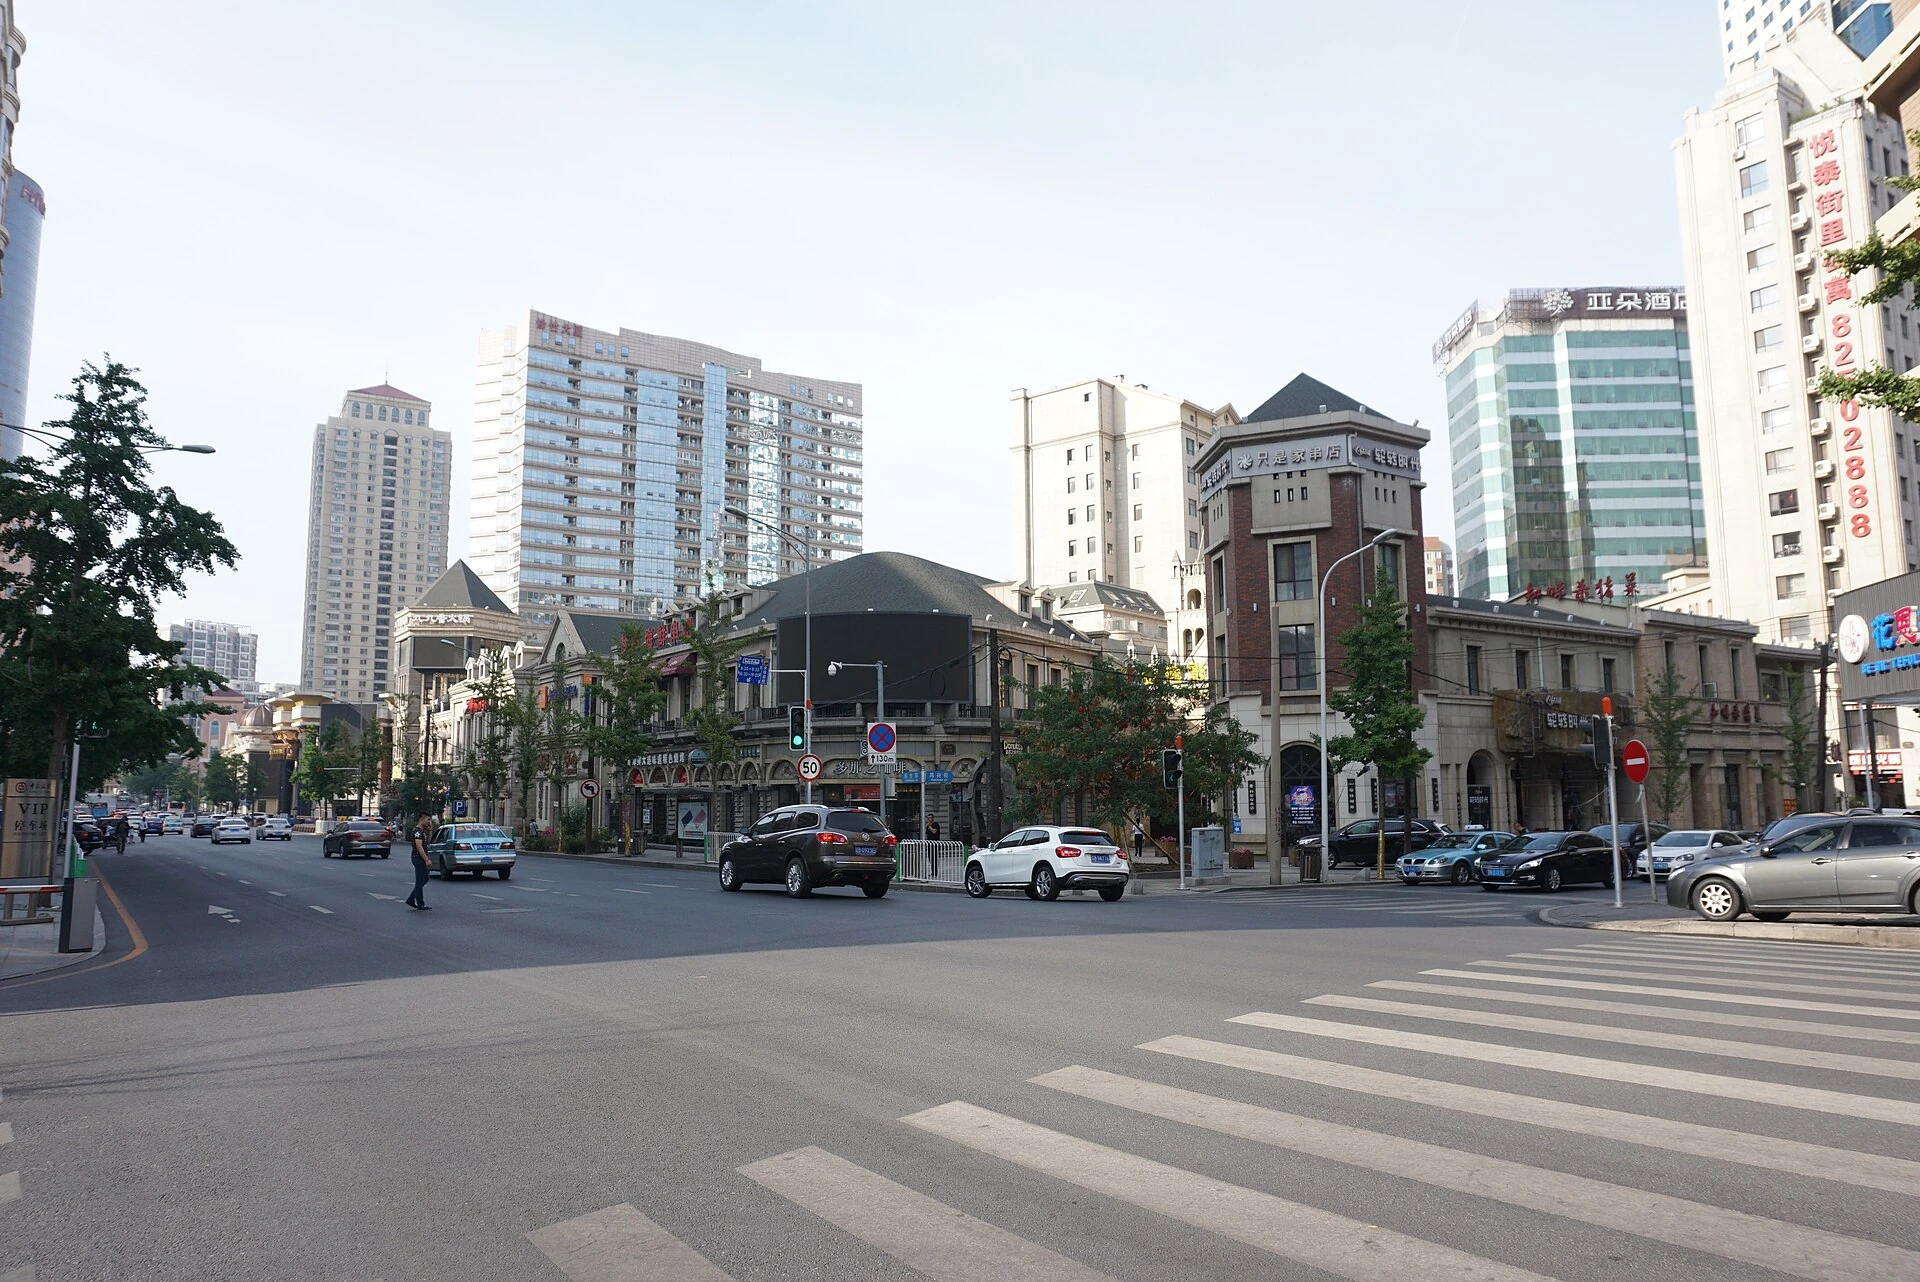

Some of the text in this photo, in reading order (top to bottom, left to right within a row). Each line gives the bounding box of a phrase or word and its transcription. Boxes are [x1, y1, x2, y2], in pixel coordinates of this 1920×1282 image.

[1831, 313, 1872, 538] 8202888
[1256, 444, 1341, 465] 只是家串店
[876, 755, 894, 763] 130m
[803, 761, 817, 774] 50
[18, 803, 48, 815] VIP
[456, 801, 463, 812] P
